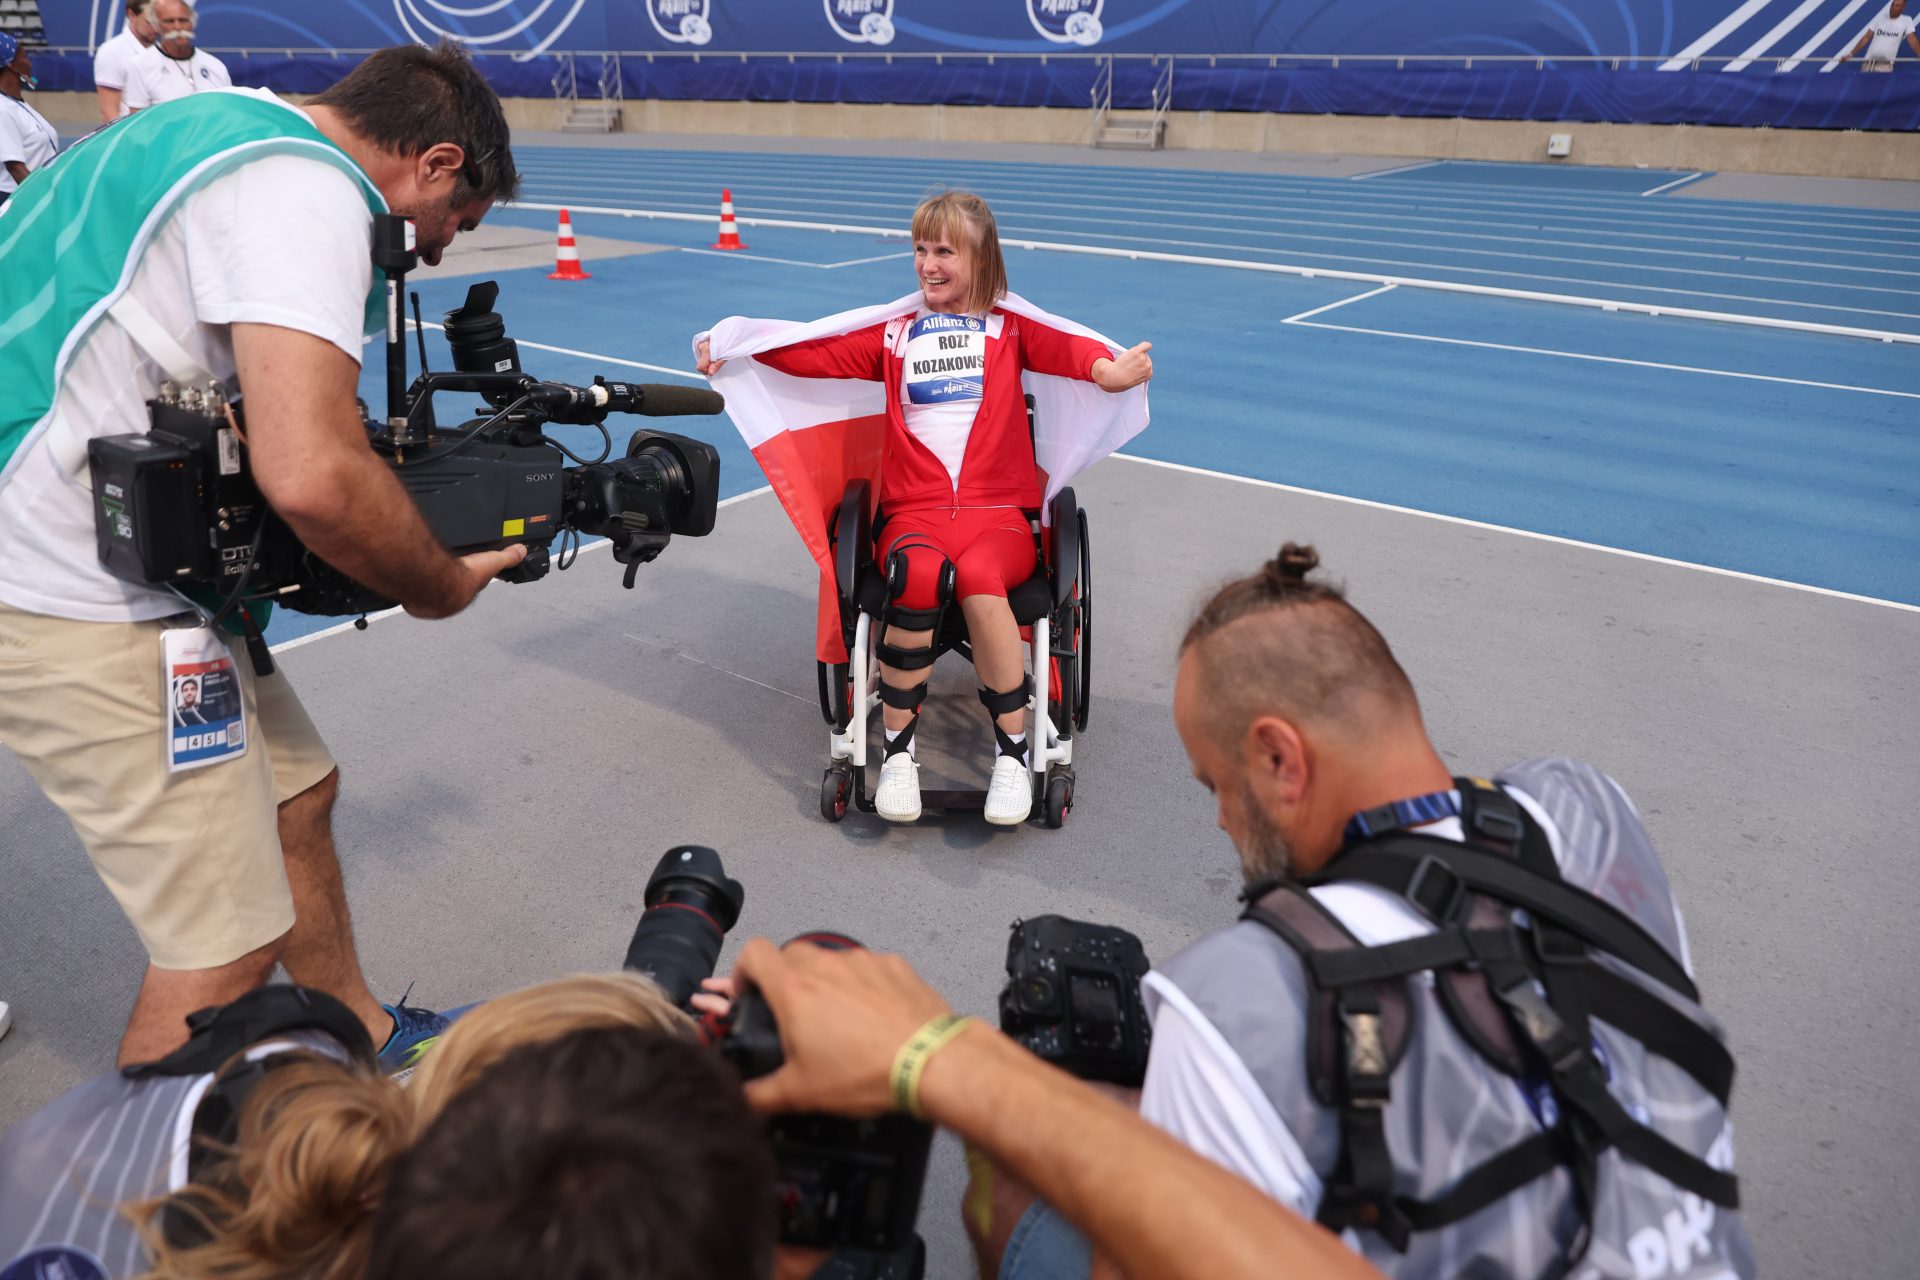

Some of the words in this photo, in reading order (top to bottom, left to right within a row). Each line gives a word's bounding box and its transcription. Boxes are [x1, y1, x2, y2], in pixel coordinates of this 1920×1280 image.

[922, 317, 965, 331] Allianz
[913, 355, 984, 375] KOZAKOWS
[526, 473, 554, 482] SONY
[192, 737, 198, 747] 4
